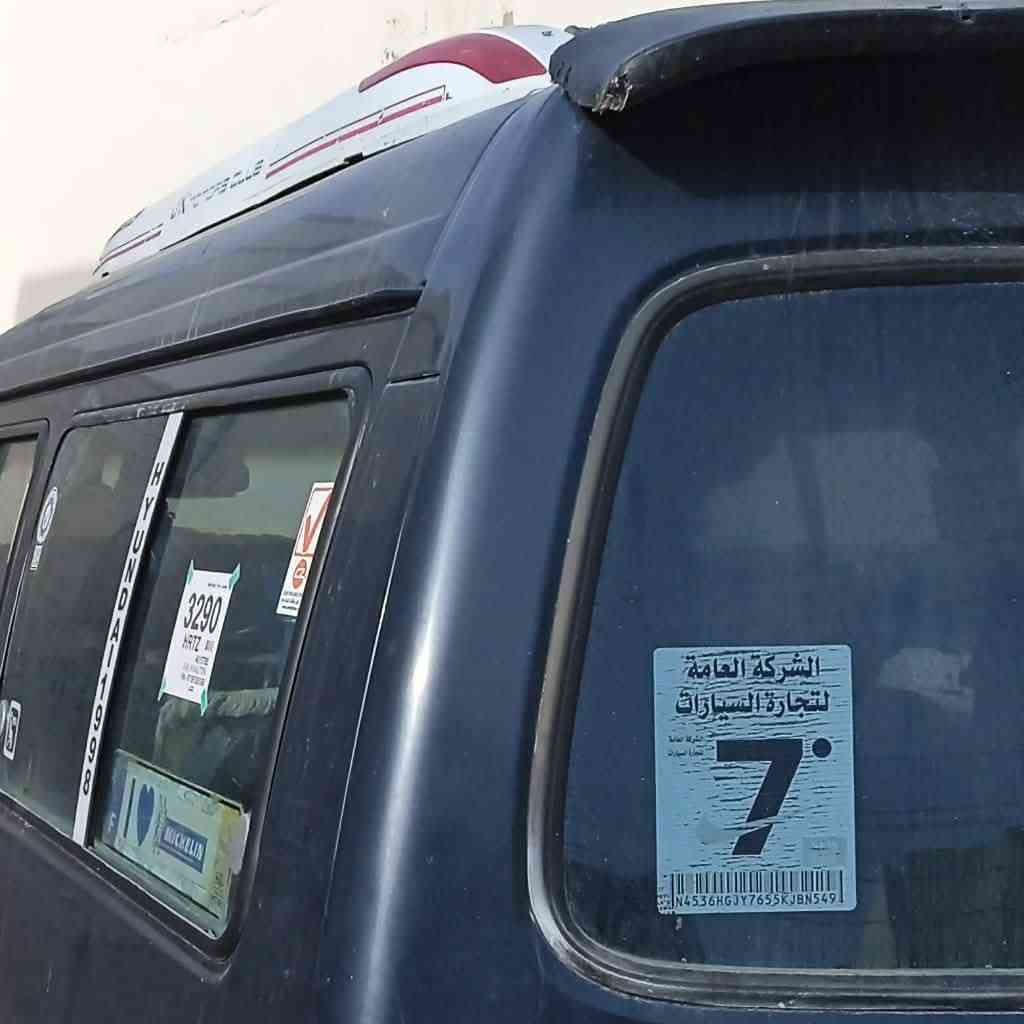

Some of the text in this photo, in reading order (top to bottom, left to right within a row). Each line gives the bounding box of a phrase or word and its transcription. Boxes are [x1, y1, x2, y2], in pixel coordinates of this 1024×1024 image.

[82, 462, 166, 795] HYUNDAI 1998
[184, 593, 222, 634] 3290
[685, 652, 820, 683] الشركة العامة
[676, 690, 830, 720] لتجارة السيارات
